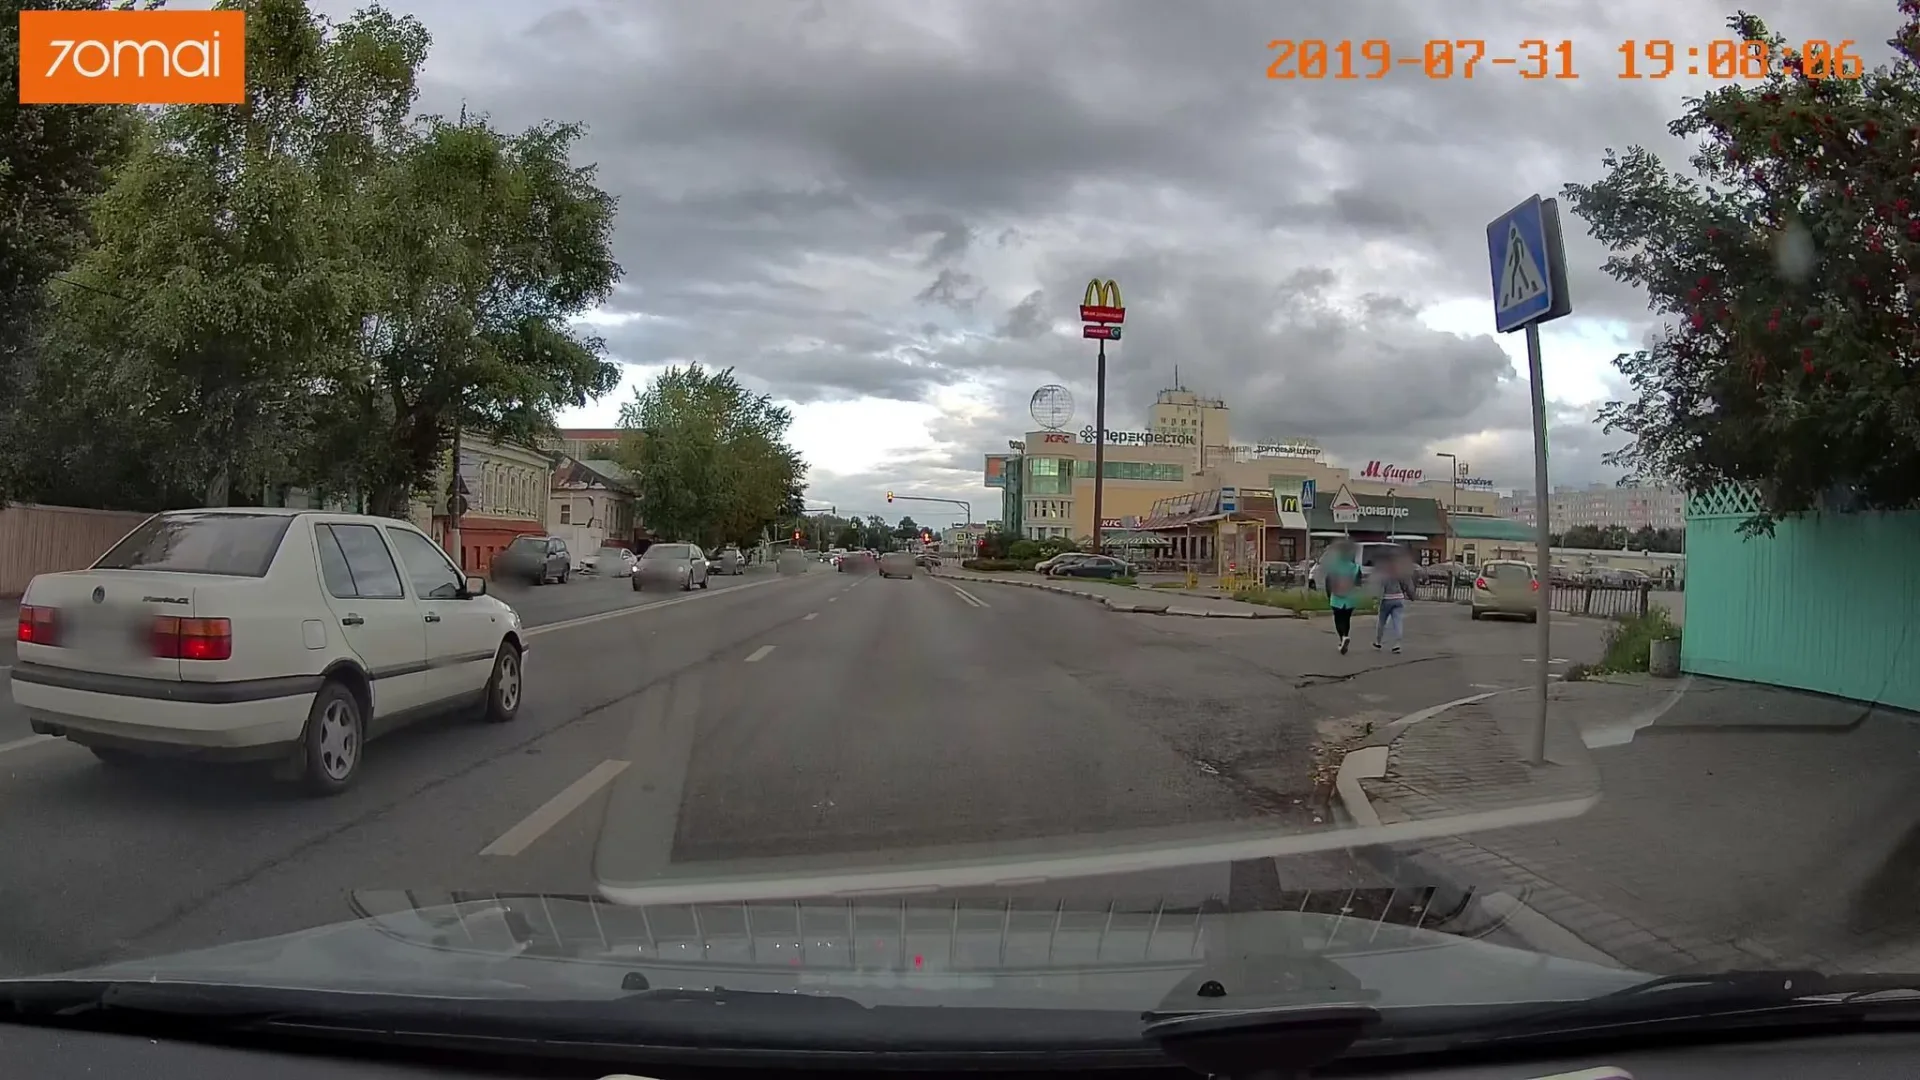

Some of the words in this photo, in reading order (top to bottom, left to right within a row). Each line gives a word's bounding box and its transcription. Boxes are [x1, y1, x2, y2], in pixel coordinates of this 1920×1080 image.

[1044, 434, 1070, 444] KFC
[1355, 505, 1409, 518] доналдс
[1102, 519, 1121, 527] KFC
